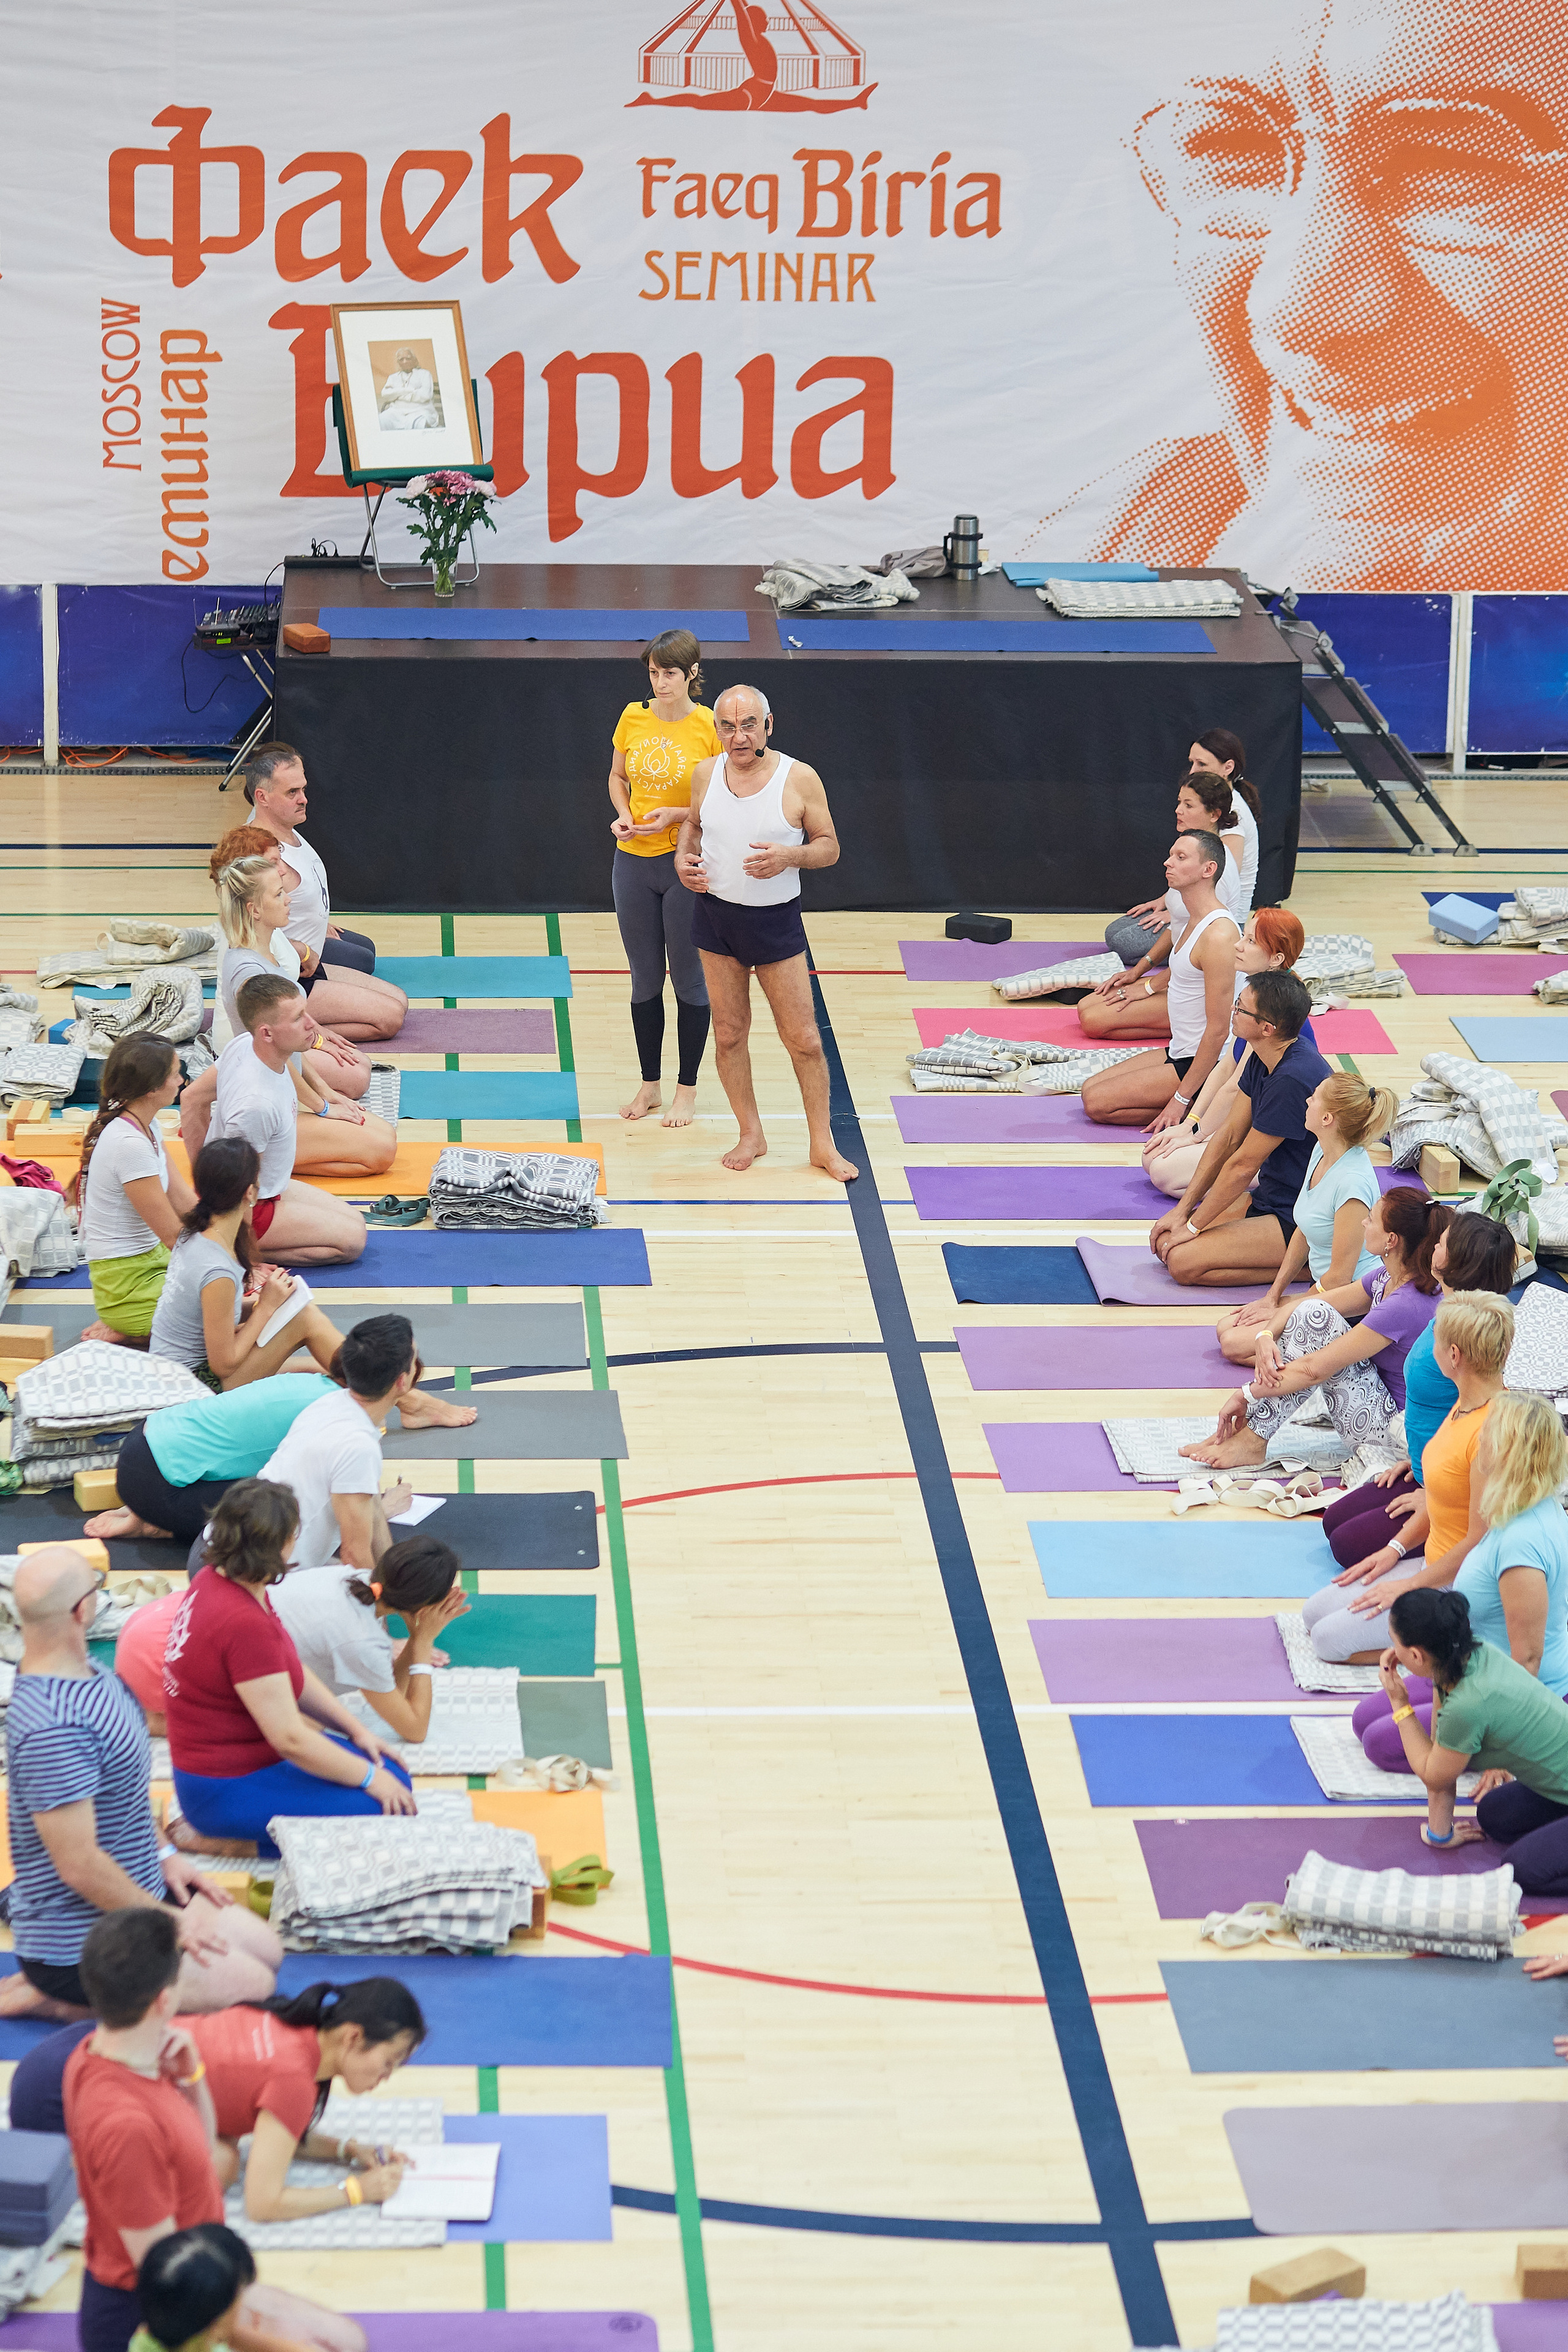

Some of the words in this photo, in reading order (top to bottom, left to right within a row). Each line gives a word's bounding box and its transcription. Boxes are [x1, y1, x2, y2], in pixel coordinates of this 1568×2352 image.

[108, 105, 583, 288] Фаек
[636, 157, 778, 233] Faeq
[793, 148, 1001, 238] Biria
[639, 251, 875, 301] SEMINAR
[101, 298, 141, 470] MOSCOW
